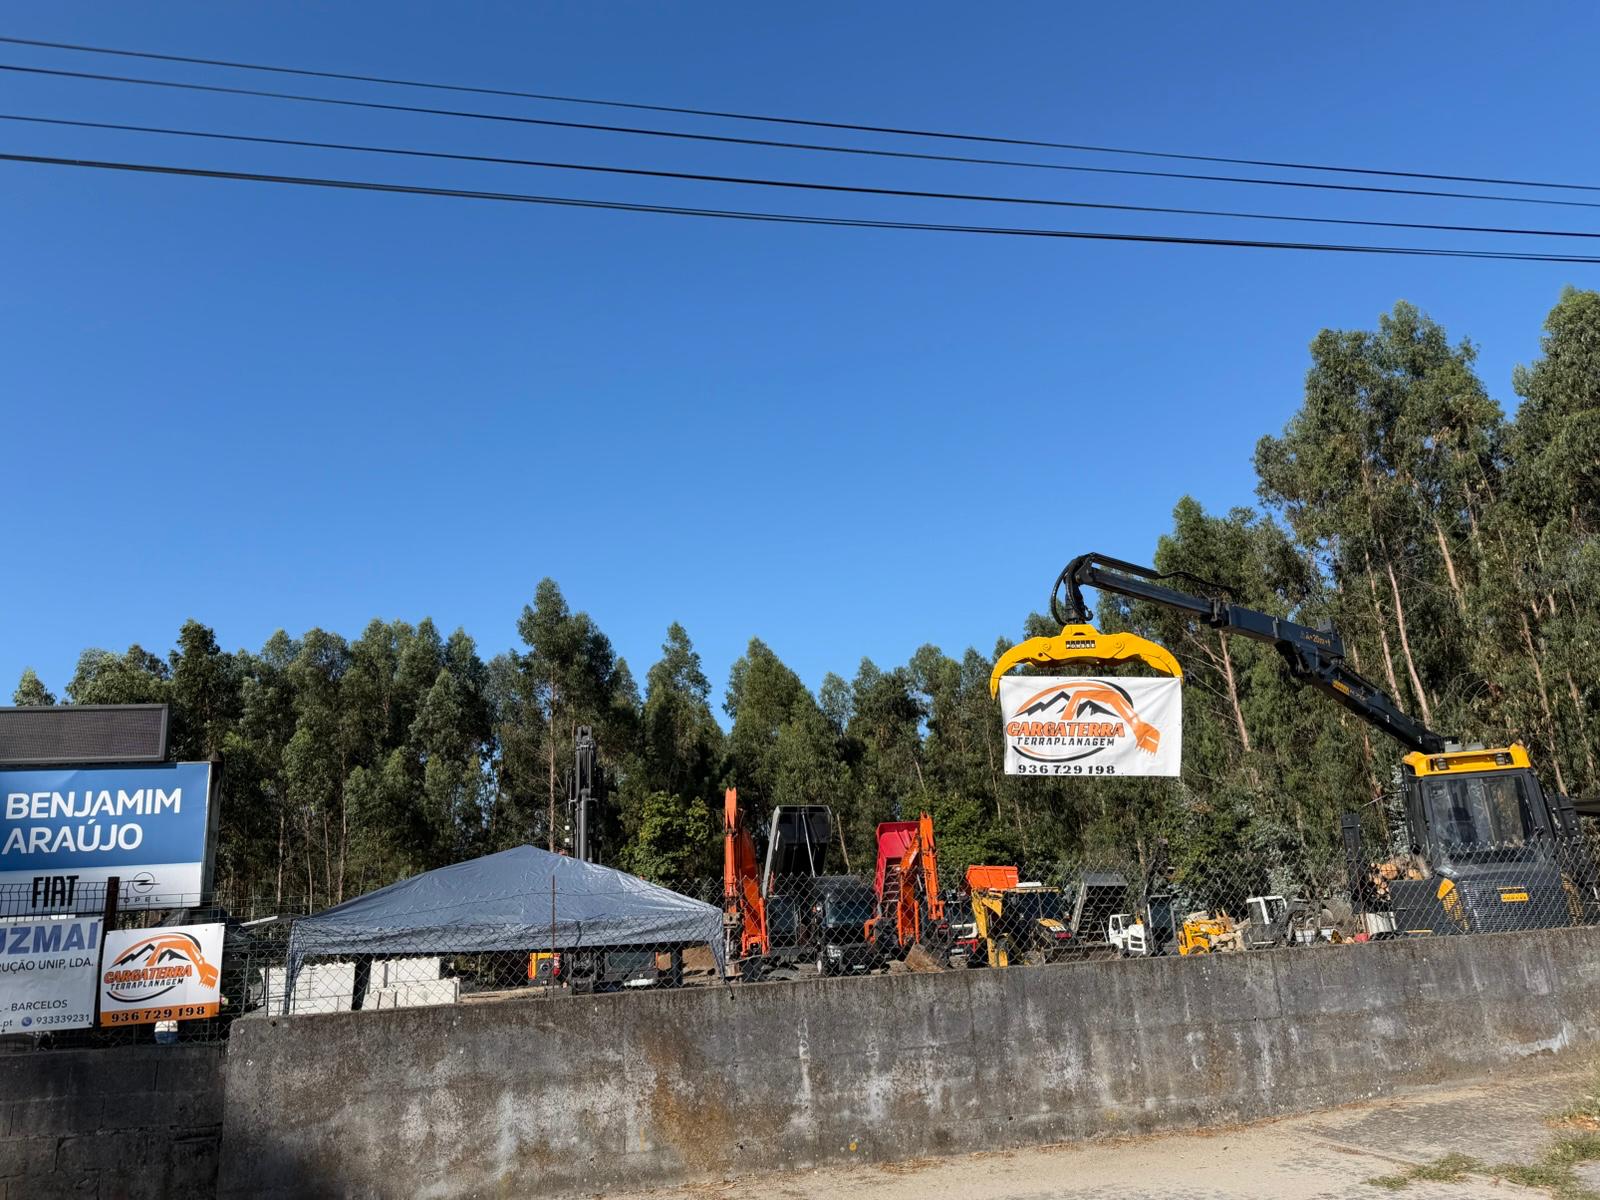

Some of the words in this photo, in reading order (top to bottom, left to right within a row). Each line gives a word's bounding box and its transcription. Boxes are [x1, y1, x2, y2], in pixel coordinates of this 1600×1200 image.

[1007, 721, 1126, 738] CARGATERRA
[1017, 736, 1115, 746] TERRAPLANAGEM
[1018, 764, 1049, 774] 936
[1053, 764, 1083, 774] 729
[1087, 765, 1116, 775] 198
[5, 787, 182, 820] BENJAMIM
[1, 818, 144, 855] ARAÚJO
[31, 874, 80, 908] FIAT
[123, 896, 161, 904] OPEL
[0, 959, 35, 974] UÇÃO
[38, 958, 66, 970] UNIP,
[69, 956, 94, 968] LDA.
[103, 964, 193, 985] CARGATERRA
[110, 977, 184, 991] TERRAPLANAGEM
[11, 999, 68, 1011] BARCELOS
[36, 1013, 90, 1025] 933339231
[111, 1012, 140, 1023] 936
[144, 1009, 172, 1020] 729
[178, 1006, 206, 1017] 198
